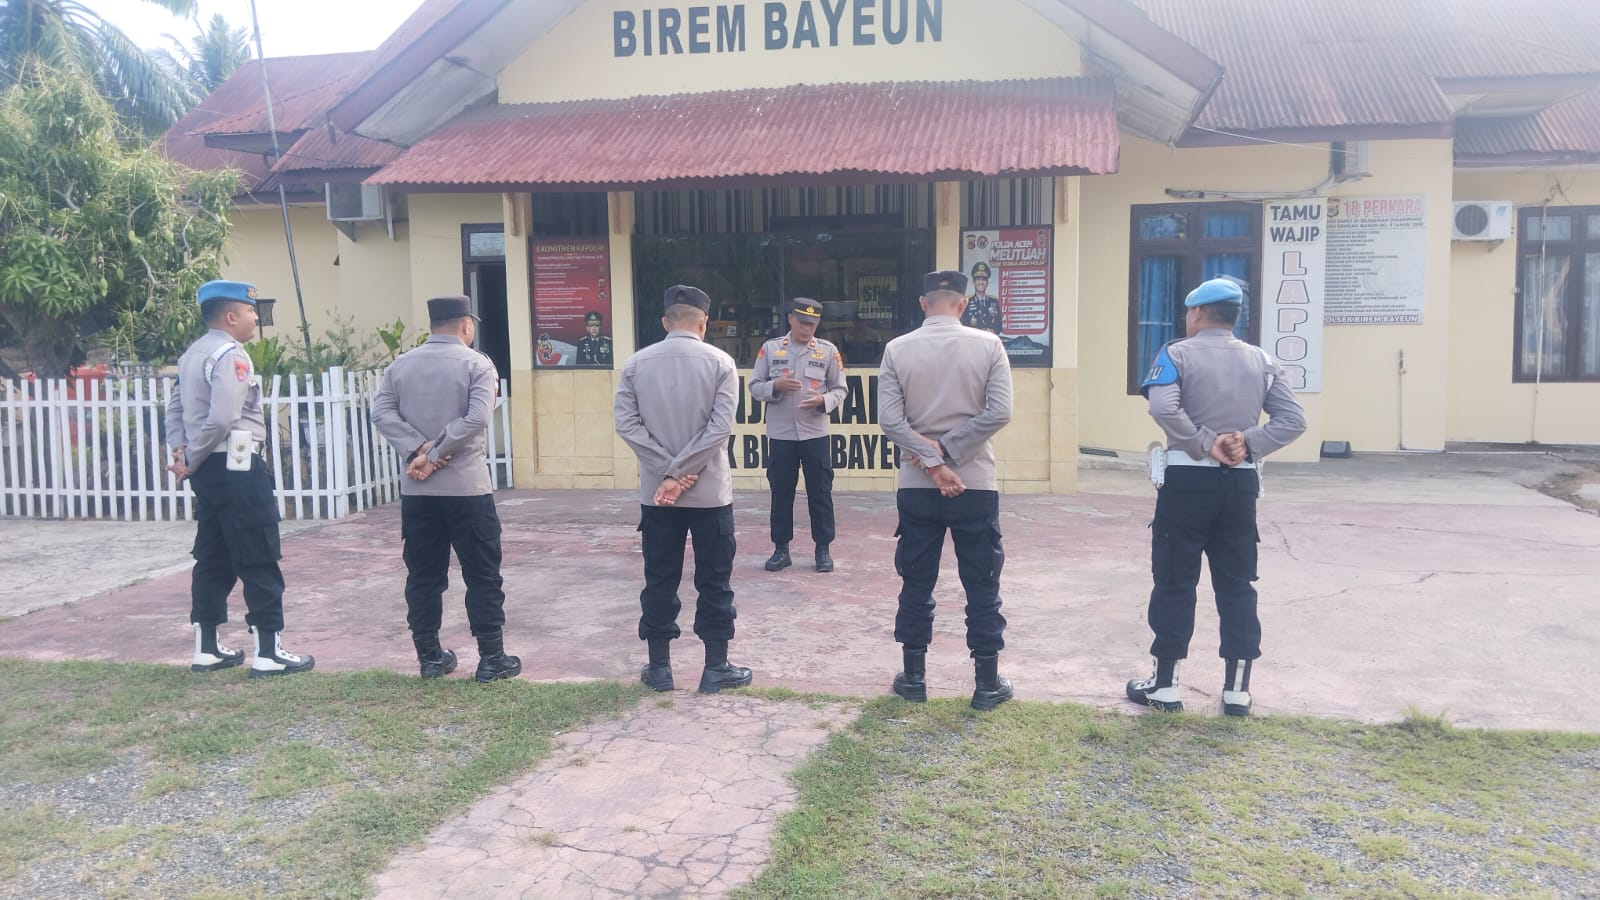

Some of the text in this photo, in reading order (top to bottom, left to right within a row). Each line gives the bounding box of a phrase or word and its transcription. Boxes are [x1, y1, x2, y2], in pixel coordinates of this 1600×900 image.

[613, 0, 942, 57] BIREM BAYEUN
[1270, 204, 1321, 221] TAMU
[1344, 199, 1422, 216] 18 PERKARA
[1270, 226, 1320, 243] WAJIP
[991, 240, 1033, 248] POLDA ACEH
[990, 247, 1047, 261] MEUTUAH
[1324, 315, 1354, 323] OLSEK
